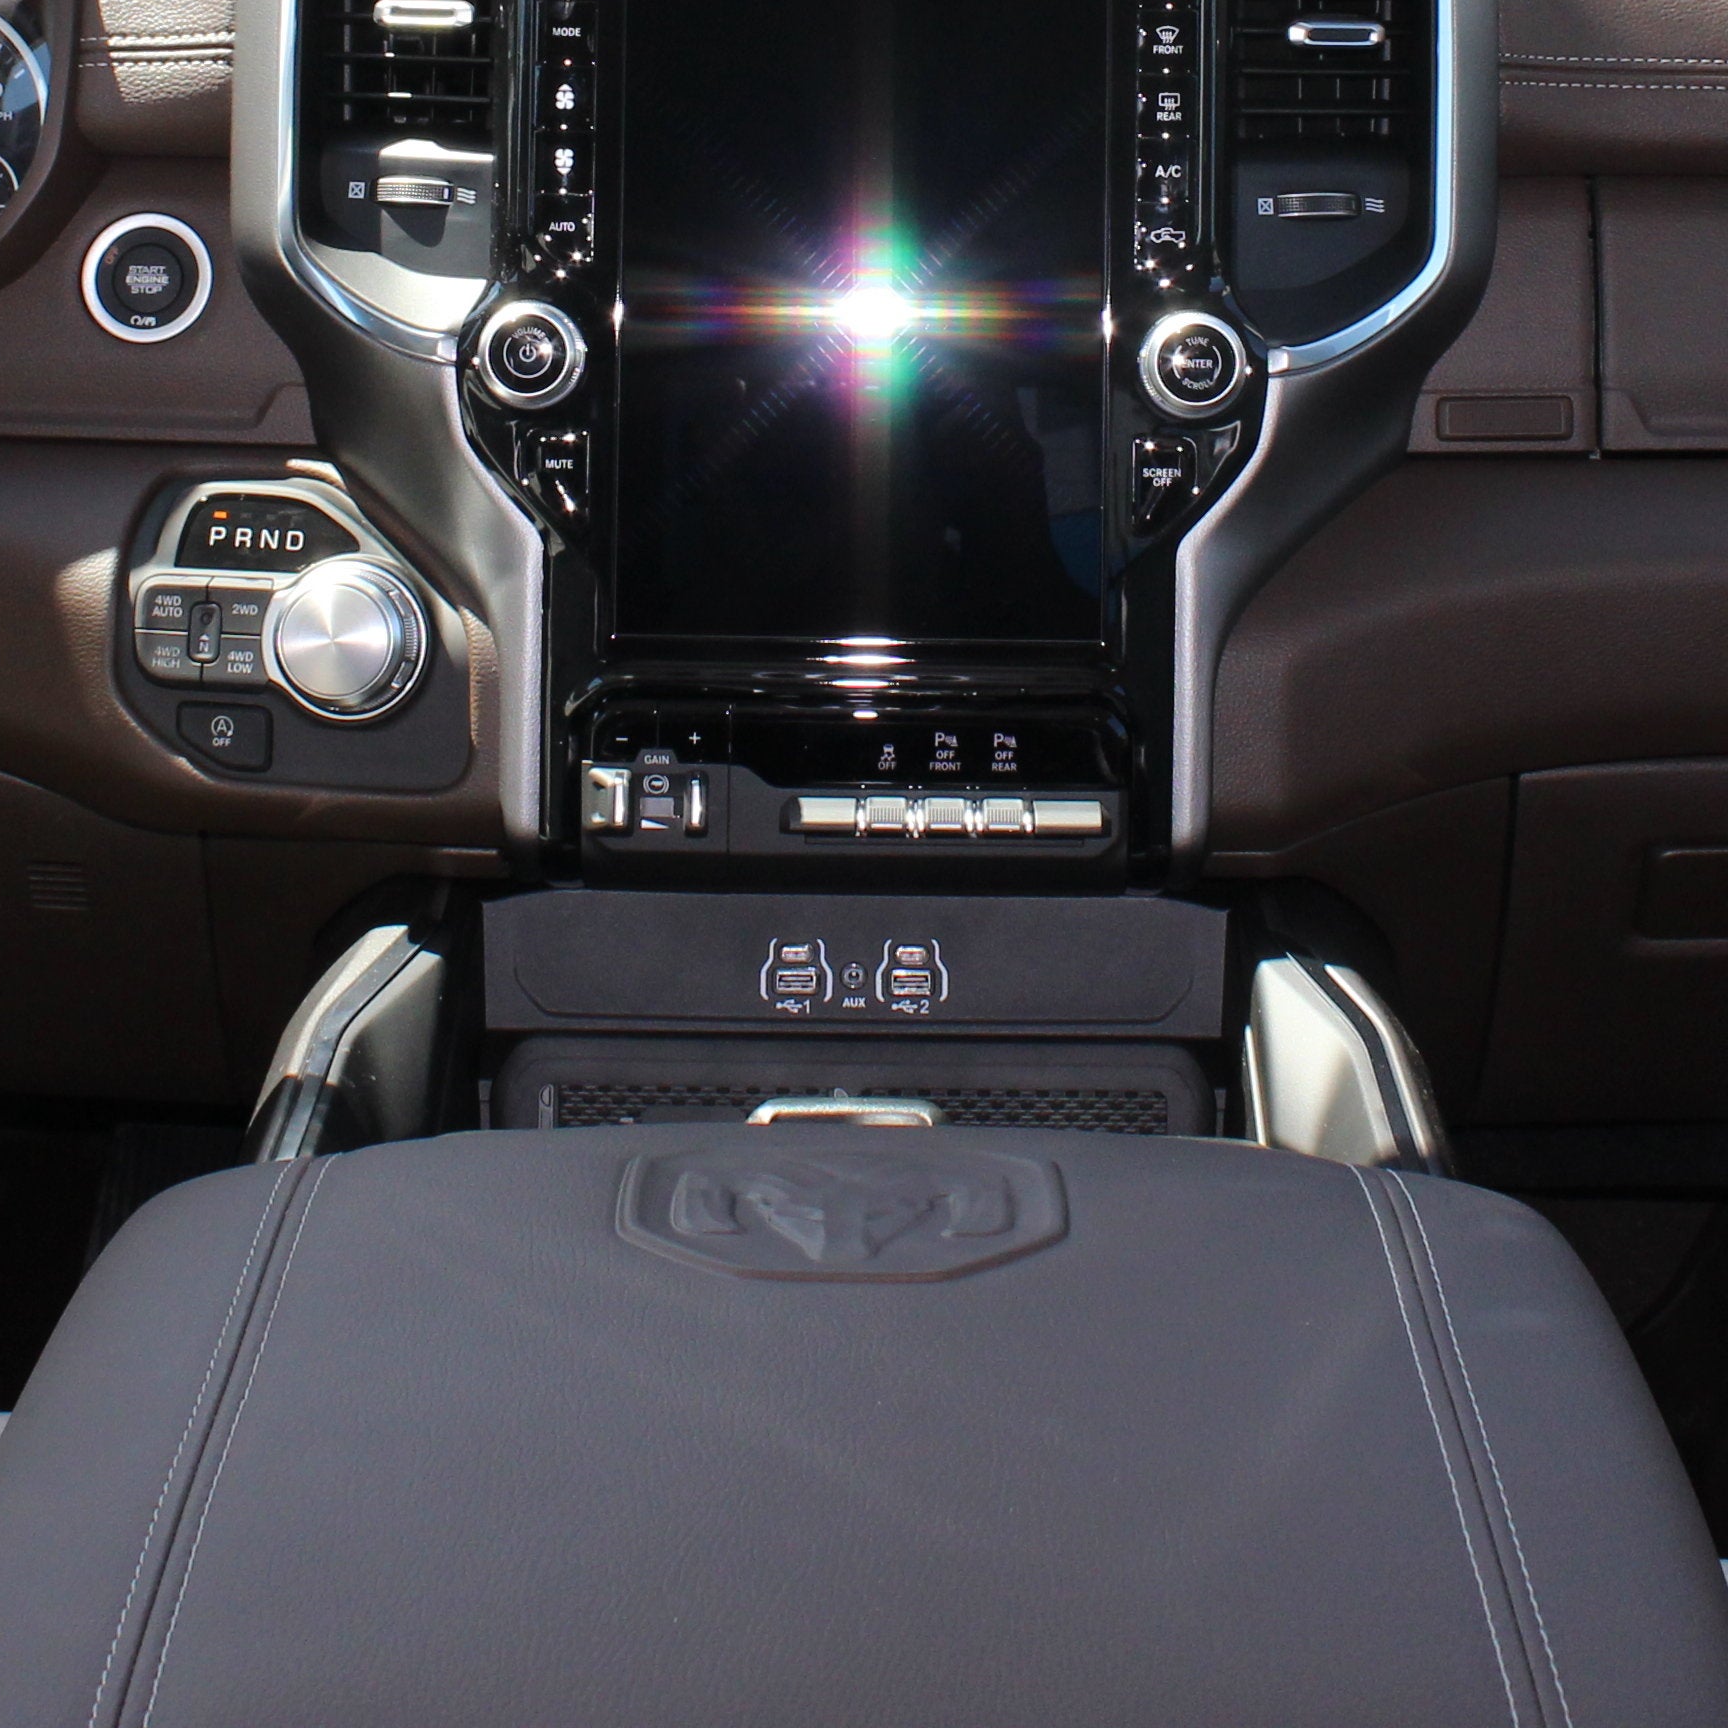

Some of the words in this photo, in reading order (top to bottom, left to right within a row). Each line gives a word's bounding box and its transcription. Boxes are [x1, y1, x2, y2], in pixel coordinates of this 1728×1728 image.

[552, 27, 581, 38] MODE
[1153, 45, 1184, 55] FRONT
[1157, 112, 1182, 122] REAR
[1155, 164, 1182, 179] A/C
[549, 221, 576, 232] AUTO
[129, 265, 166, 275] START
[126, 275, 170, 285] ENGINE
[131, 285, 163, 294] STOP
[512, 326, 547, 340] VOLUME
[1185, 336, 1210, 347] TUNE
[1182, 377, 1213, 391] SCROLL
[545, 458, 574, 469] MUTE
[1142, 468, 1182, 478] SCREEN
[1152, 478, 1172, 488] OFF
[154, 595, 182, 606] 4WD
[152, 607, 183, 618] AUTO
[232, 603, 259, 616] 2WD
[154, 646, 181, 657] 4WD
[227, 651, 254, 662] 4WD
[151, 657, 181, 669] HIGH
[227, 663, 254, 674] LOW
[213, 738, 231, 747] OFF
[644, 754, 670, 765] GAIN
[936, 750, 955, 760] OFF
[995, 751, 1014, 760] OFF
[878, 761, 897, 771] OFF
[929, 761, 962, 771] FRONT
[992, 762, 1017, 772] REAR
[842, 997, 867, 1008] AUX
[920, 1001, 930, 1014] 2
